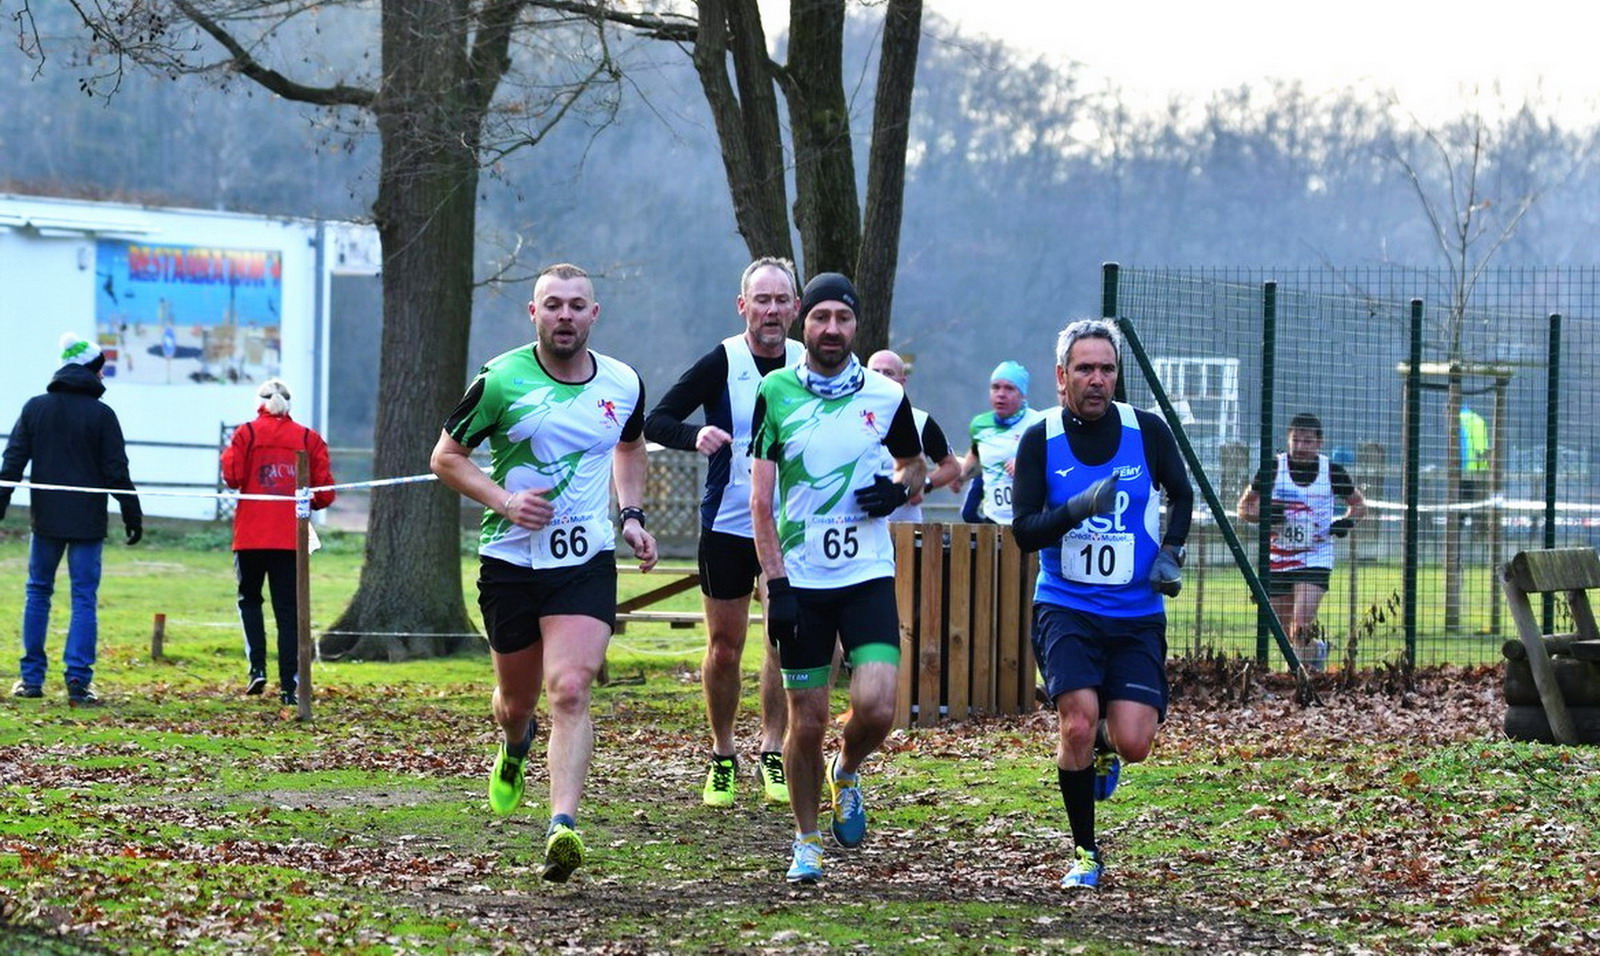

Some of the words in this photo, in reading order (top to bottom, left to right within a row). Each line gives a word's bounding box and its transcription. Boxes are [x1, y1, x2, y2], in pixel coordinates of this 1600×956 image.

[994, 486, 1012, 506] 60
[550, 525, 588, 559] 66
[823, 526, 858, 560] 65
[1069, 530, 1092, 541] Crédit
[1284, 526, 1305, 543] 46
[1080, 543, 1116, 577] 10
